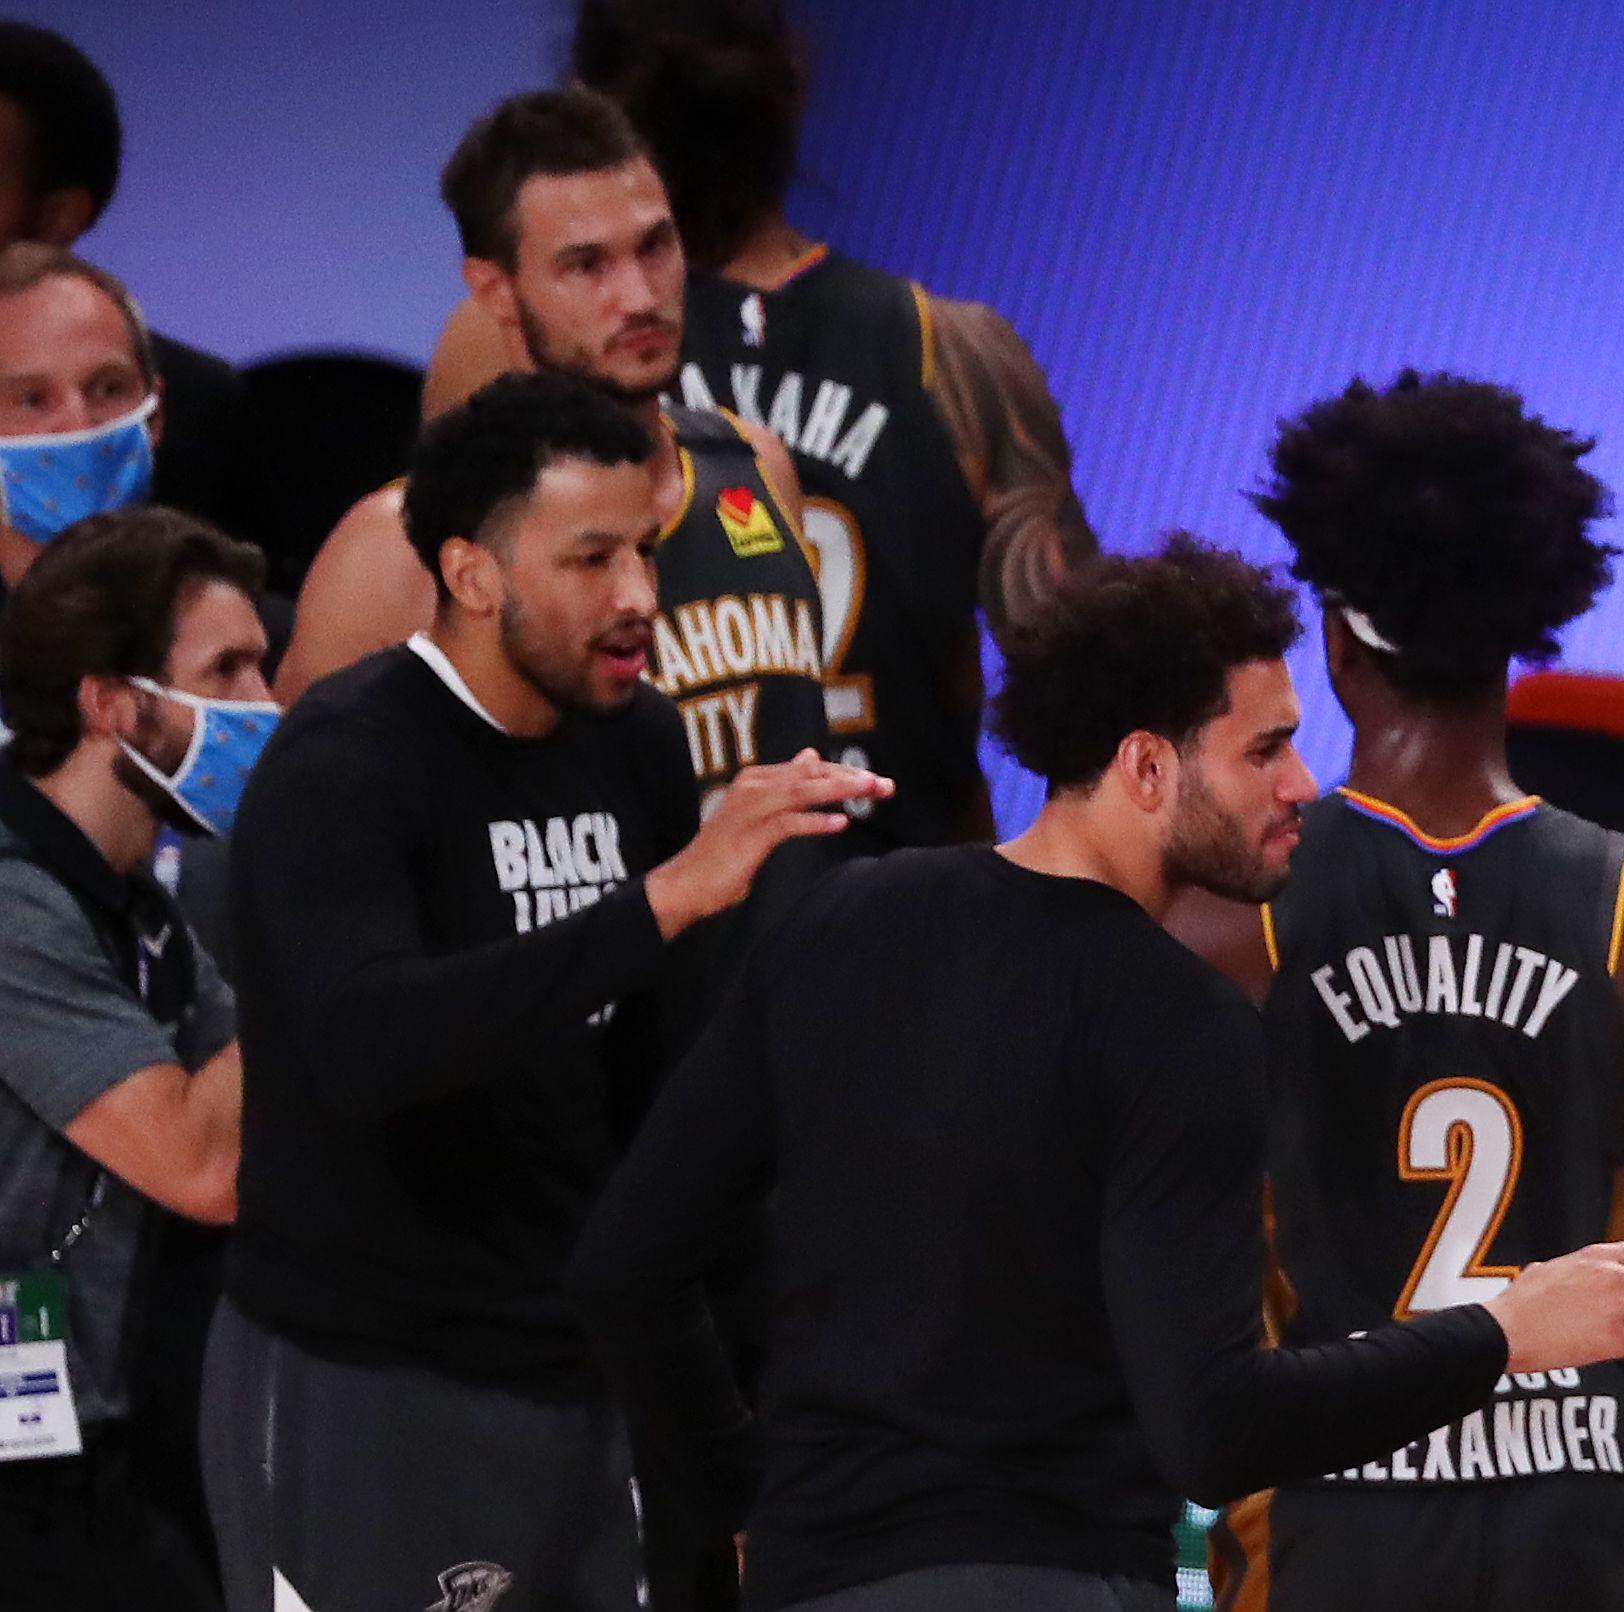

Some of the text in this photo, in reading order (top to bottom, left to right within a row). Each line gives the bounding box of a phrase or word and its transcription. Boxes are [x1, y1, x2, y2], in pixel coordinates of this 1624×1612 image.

[488, 811, 628, 891] BLACK
[1310, 933, 1580, 1043] EQUALITY
[1393, 1076, 1525, 1321] 2
